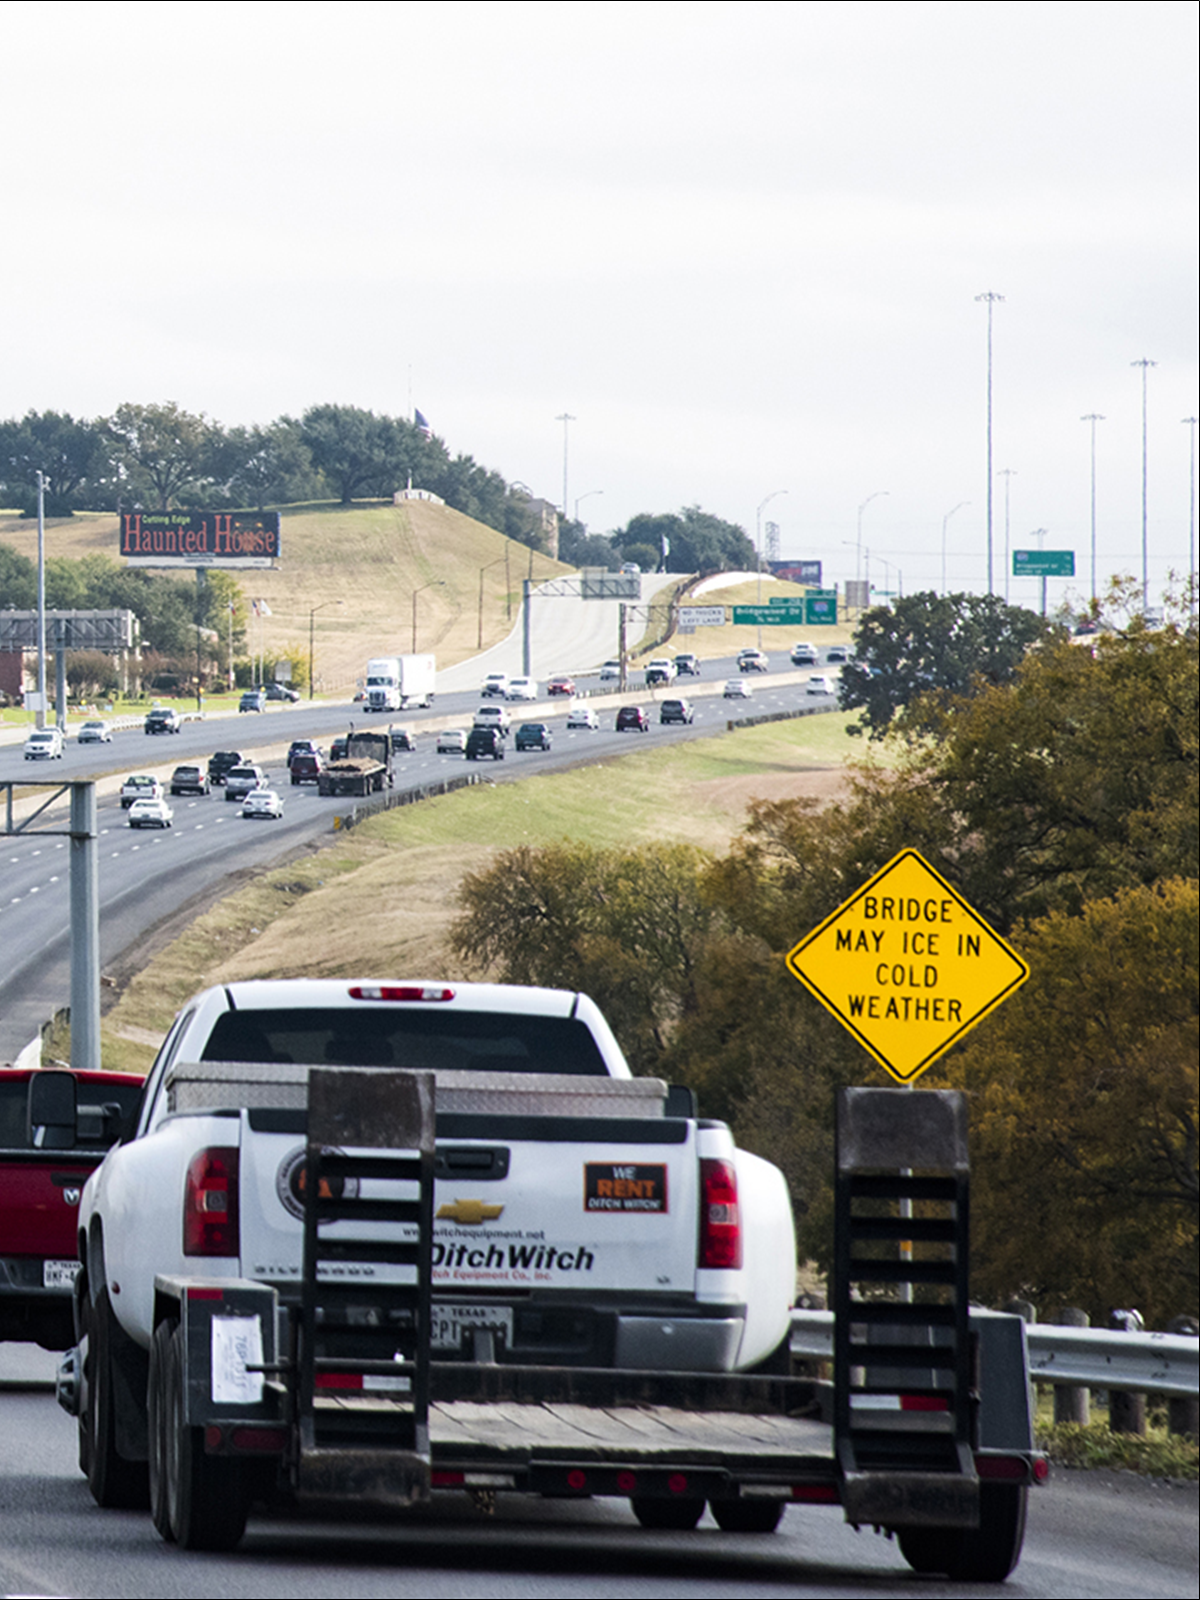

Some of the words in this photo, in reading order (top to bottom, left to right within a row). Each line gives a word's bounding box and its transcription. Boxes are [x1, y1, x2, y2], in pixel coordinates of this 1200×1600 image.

[142, 515, 169, 525] Cutting
[172, 515, 191, 525] Edge
[123, 514, 207, 552] Haunted
[864, 896, 953, 923] BRIDGE
[835, 929, 885, 953] MAY
[903, 931, 939, 956] ICE
[958, 934, 980, 957] IN
[876, 963, 938, 988] COLD
[848, 994, 962, 1022] WEATHER
[612, 1166, 636, 1179] WE
[597, 1179, 655, 1198] RENT
[588, 1198, 621, 1209] DITCH
[453, 1271, 509, 1281] Equipment
[451, 1307, 486, 1317] TEXAS
